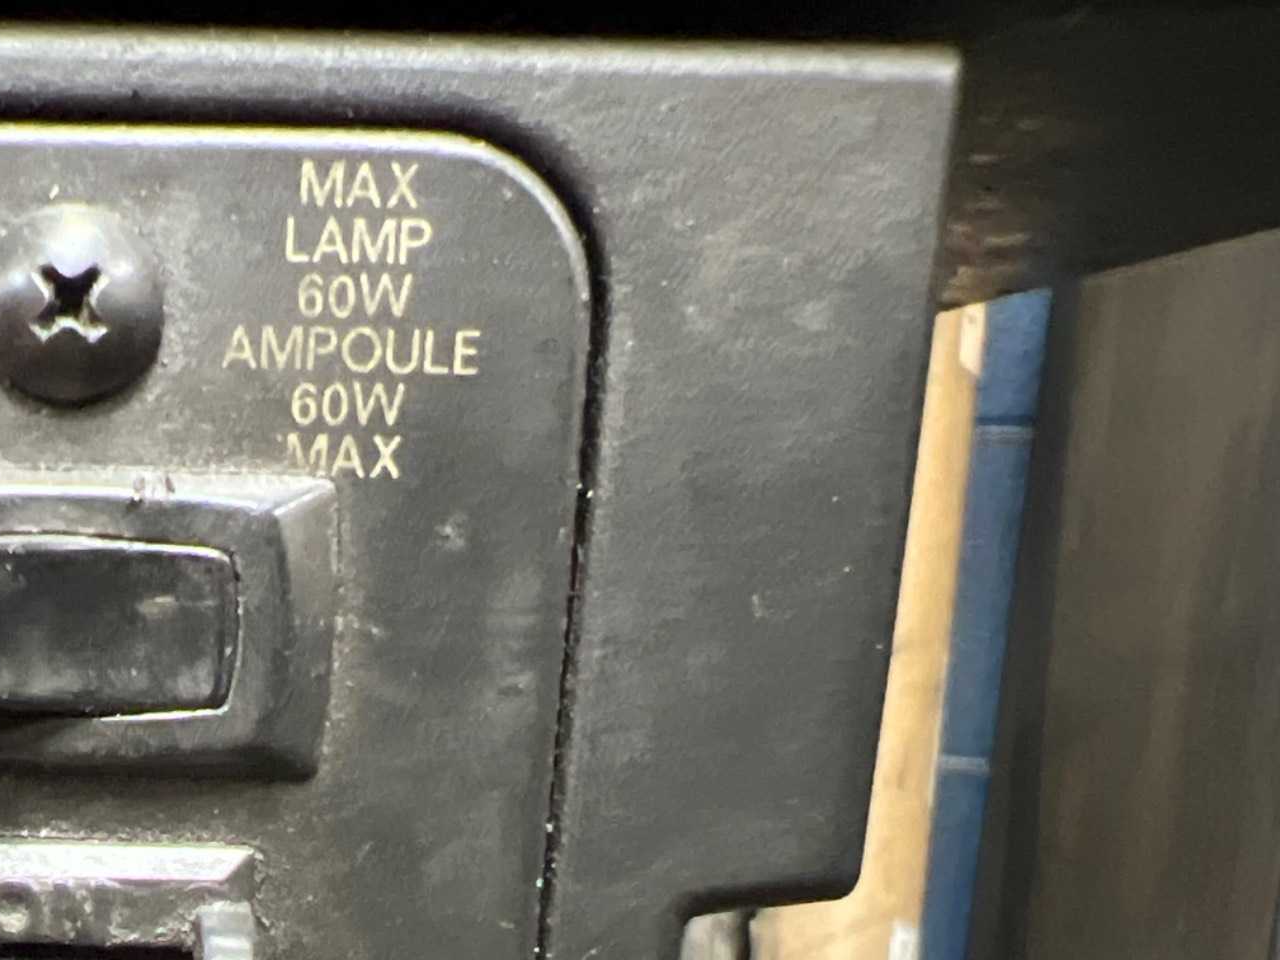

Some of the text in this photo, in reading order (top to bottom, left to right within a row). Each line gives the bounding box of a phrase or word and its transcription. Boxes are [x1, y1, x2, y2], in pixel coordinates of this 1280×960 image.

[299, 157, 419, 209] MAX
[284, 214, 433, 266] LAMP
[297, 271, 414, 319] 60W
[222, 324, 483, 376] AMPOULE
[290, 381, 406, 427] 60W
[286, 431, 402, 480] MAX
